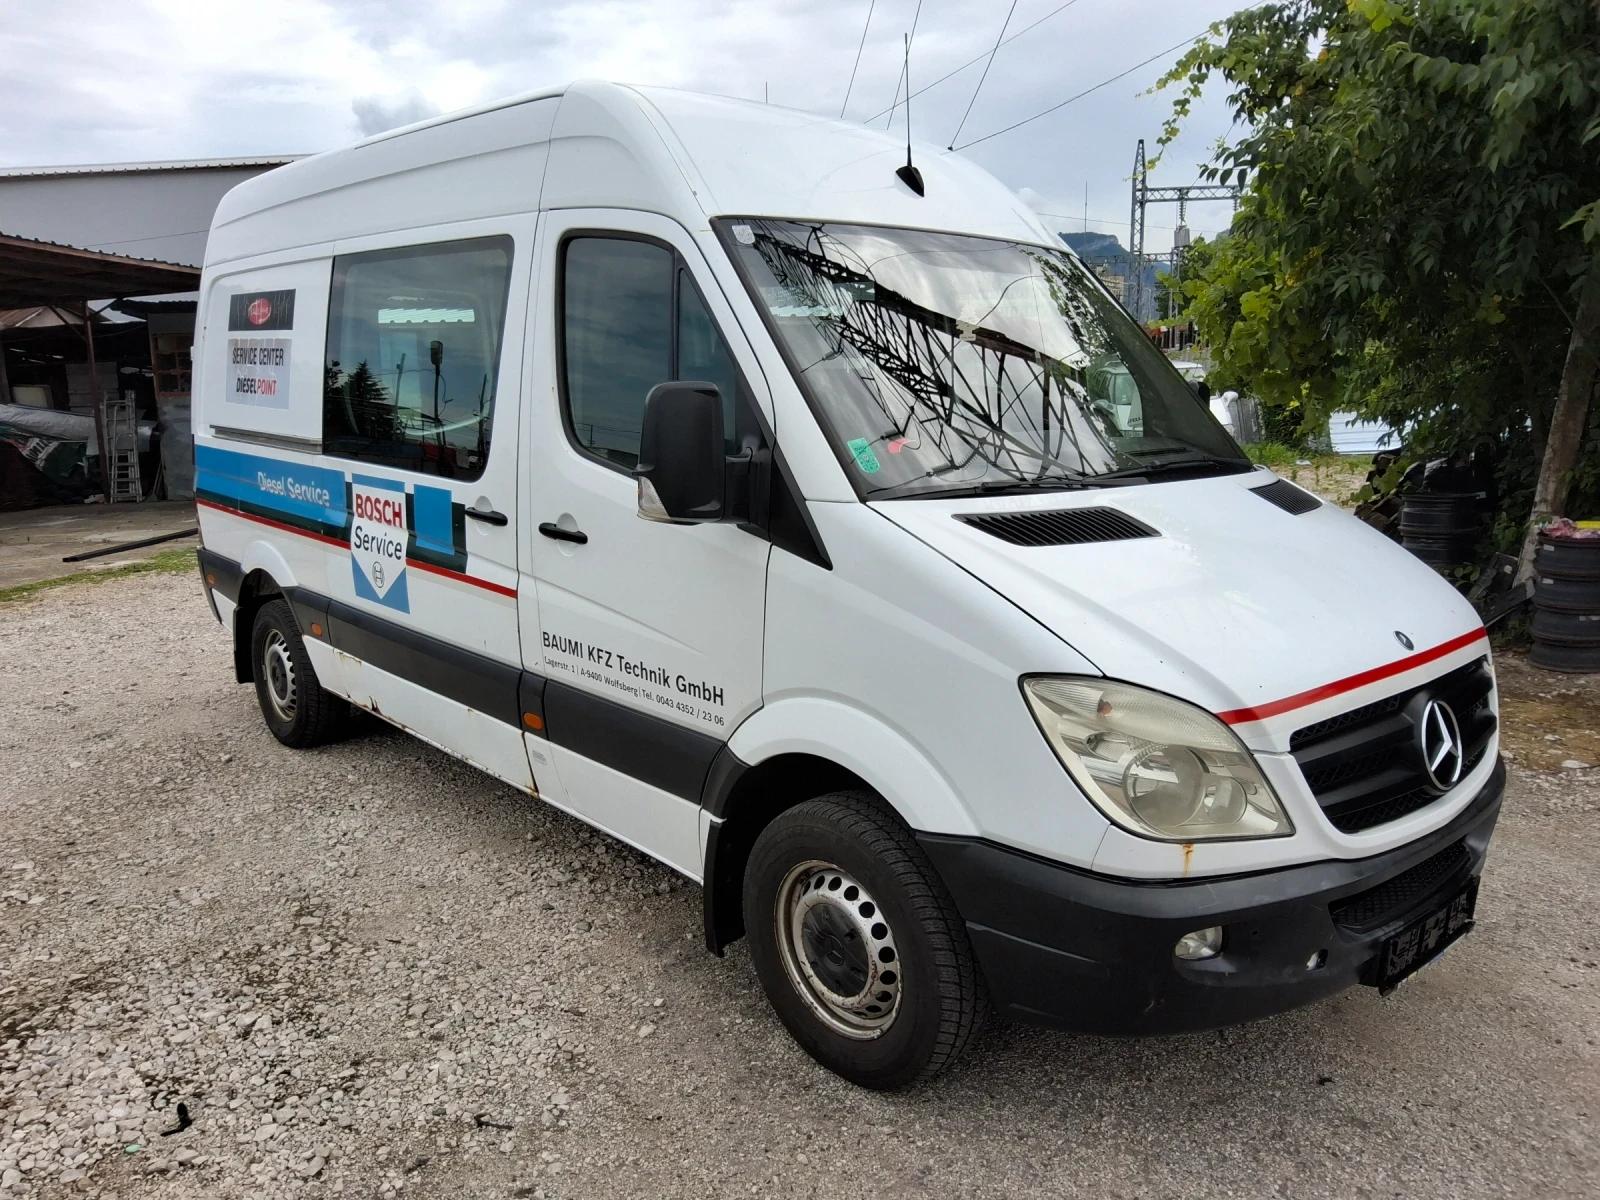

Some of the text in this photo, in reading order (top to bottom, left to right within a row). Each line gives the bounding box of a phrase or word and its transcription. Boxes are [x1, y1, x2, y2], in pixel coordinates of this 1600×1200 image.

[232, 347, 284, 366] SERVICE CENTER
[257, 471, 330, 507] Diesel Service
[355, 493, 403, 528] BOSCH
[354, 525, 402, 560] Service
[542, 631, 724, 706] BAUMI KFZ Technik GmbH
[545, 656, 570, 671] Lagerstr.
[580, 668, 602, 682] A-9400
[604, 675, 638, 697] Wolfsberg
[656, 694, 674, 708] 0043
[676, 702, 694, 716] 4352
[702, 711, 712, 722] 23
[714, 715, 724, 726] 06
